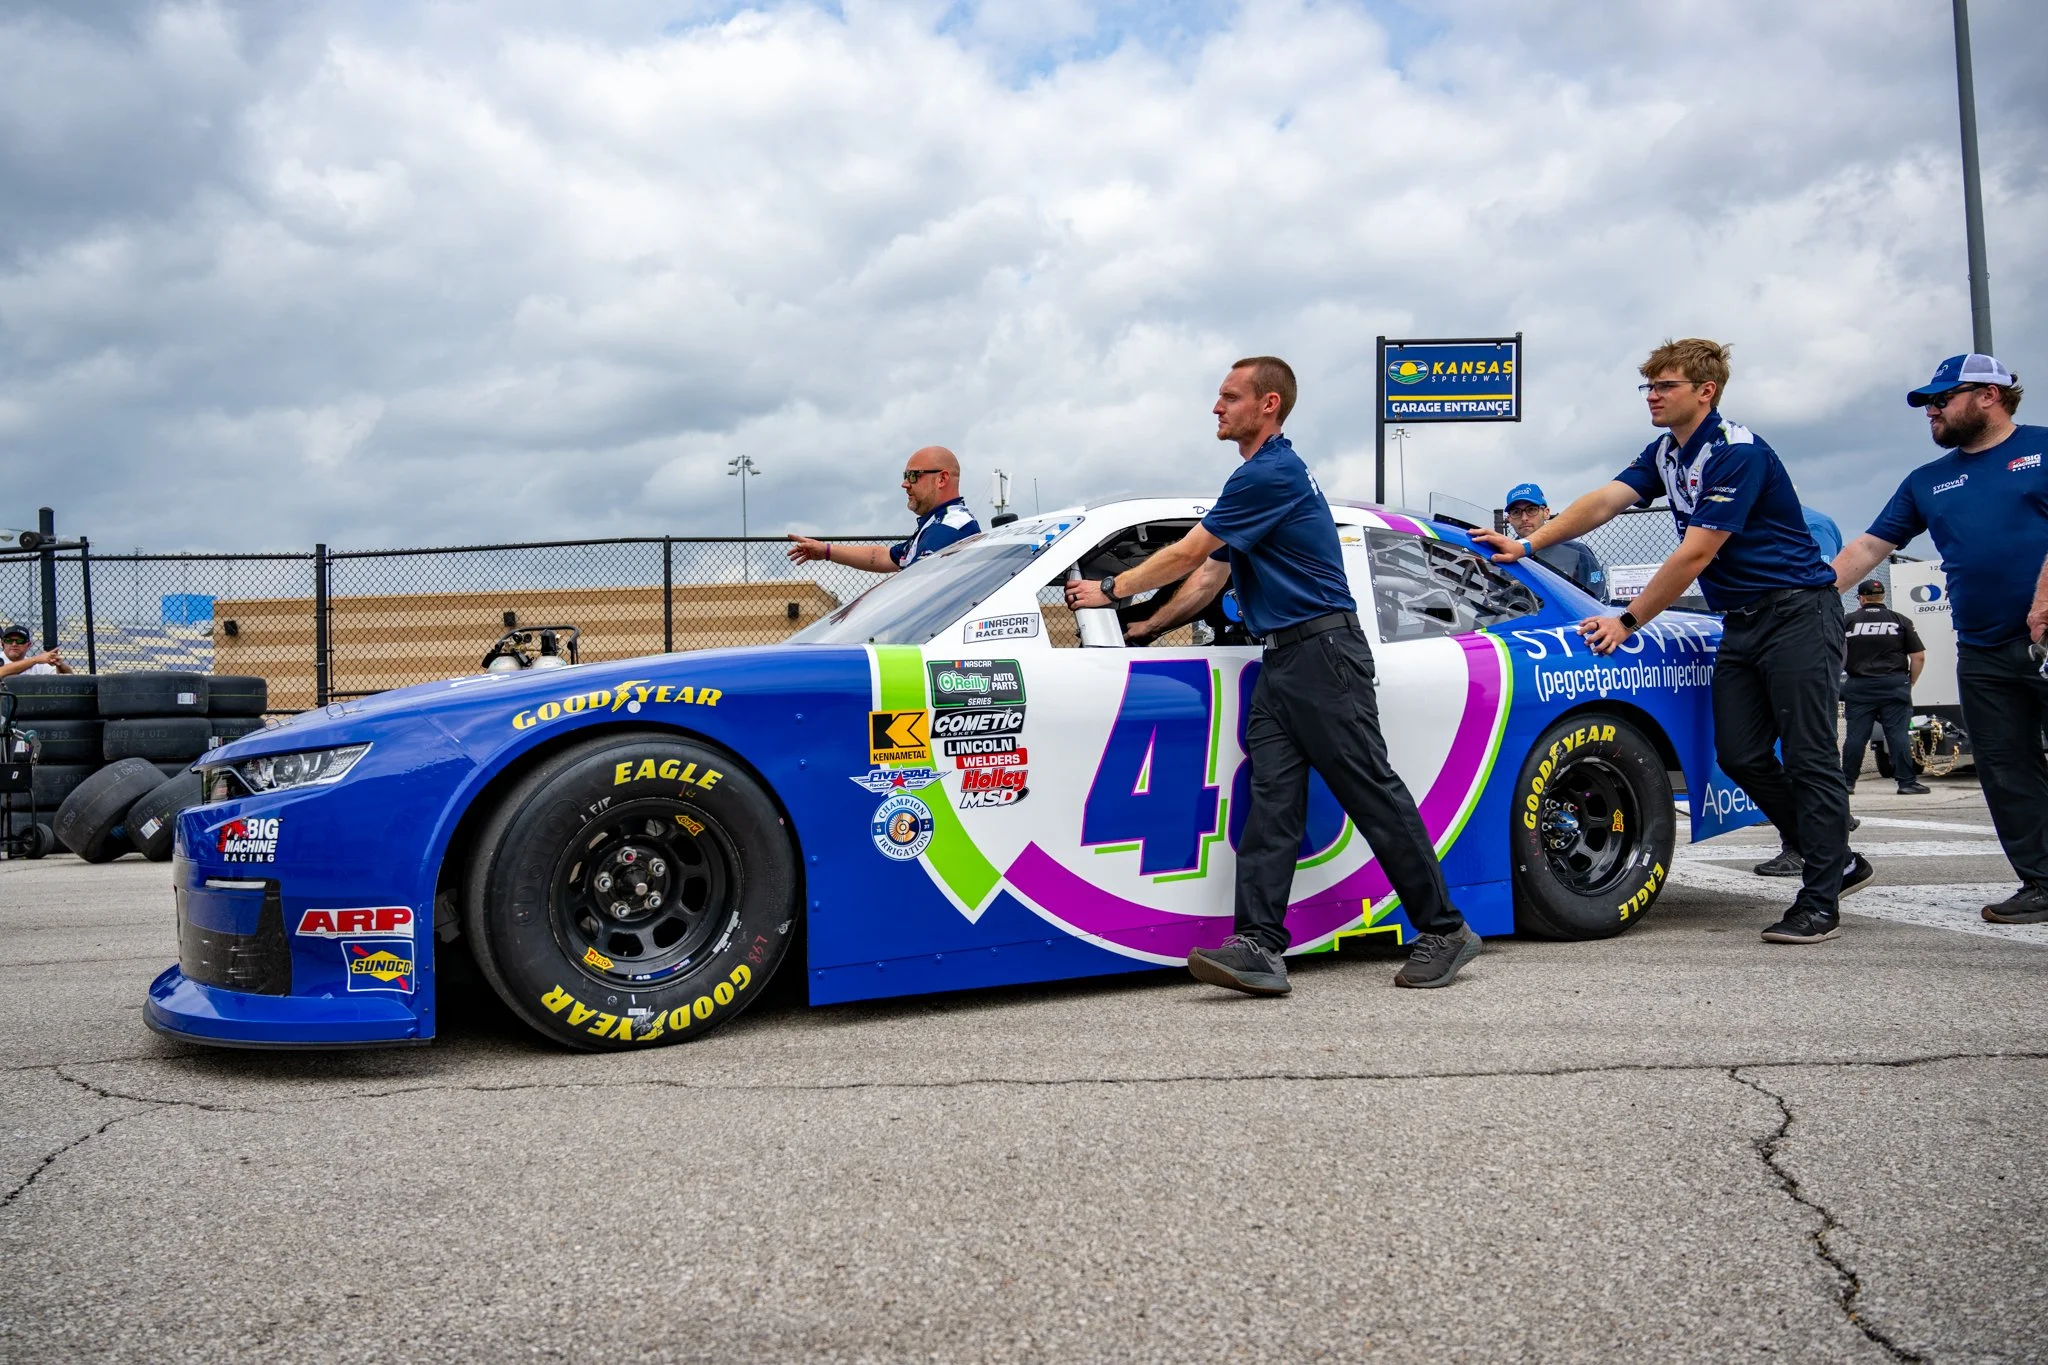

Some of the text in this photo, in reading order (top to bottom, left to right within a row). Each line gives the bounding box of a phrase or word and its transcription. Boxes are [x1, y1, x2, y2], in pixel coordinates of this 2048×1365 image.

[1432, 361, 1512, 375] KANSAS
[1392, 401, 1511, 413] GARAGE ENTRANCE
[988, 617, 1029, 628] NASCAR
[1845, 622, 1899, 637] JGR
[976, 627, 1028, 638] RACE CAR
[964, 660, 992, 668] NASCAR
[939, 672, 1014, 692] O'Reilly AUTO
[991, 681, 1018, 690] PARTS
[967, 697, 992, 706] SERIES
[935, 711, 1022, 733] COMETIC
[947, 738, 1013, 755] LINCOLN
[873, 750, 926, 761] KENNAMETAL
[963, 754, 1021, 767] WELDERS
[613, 759, 723, 790] EAGLE
[870, 769, 931, 782] FIVE STAR
[962, 767, 1028, 792] Holley
[960, 789, 1019, 809] MSD
[879, 798, 926, 819] CHAMPION
[247, 818, 279, 840] BIG
[224, 840, 277, 853] MACHINE
[879, 833, 928, 857] IRRIGATION
[224, 853, 275, 862] RACING
[1618, 862, 1664, 921] EAGLE
[299, 908, 411, 932] ARP
[354, 960, 410, 974] SUNOCO
